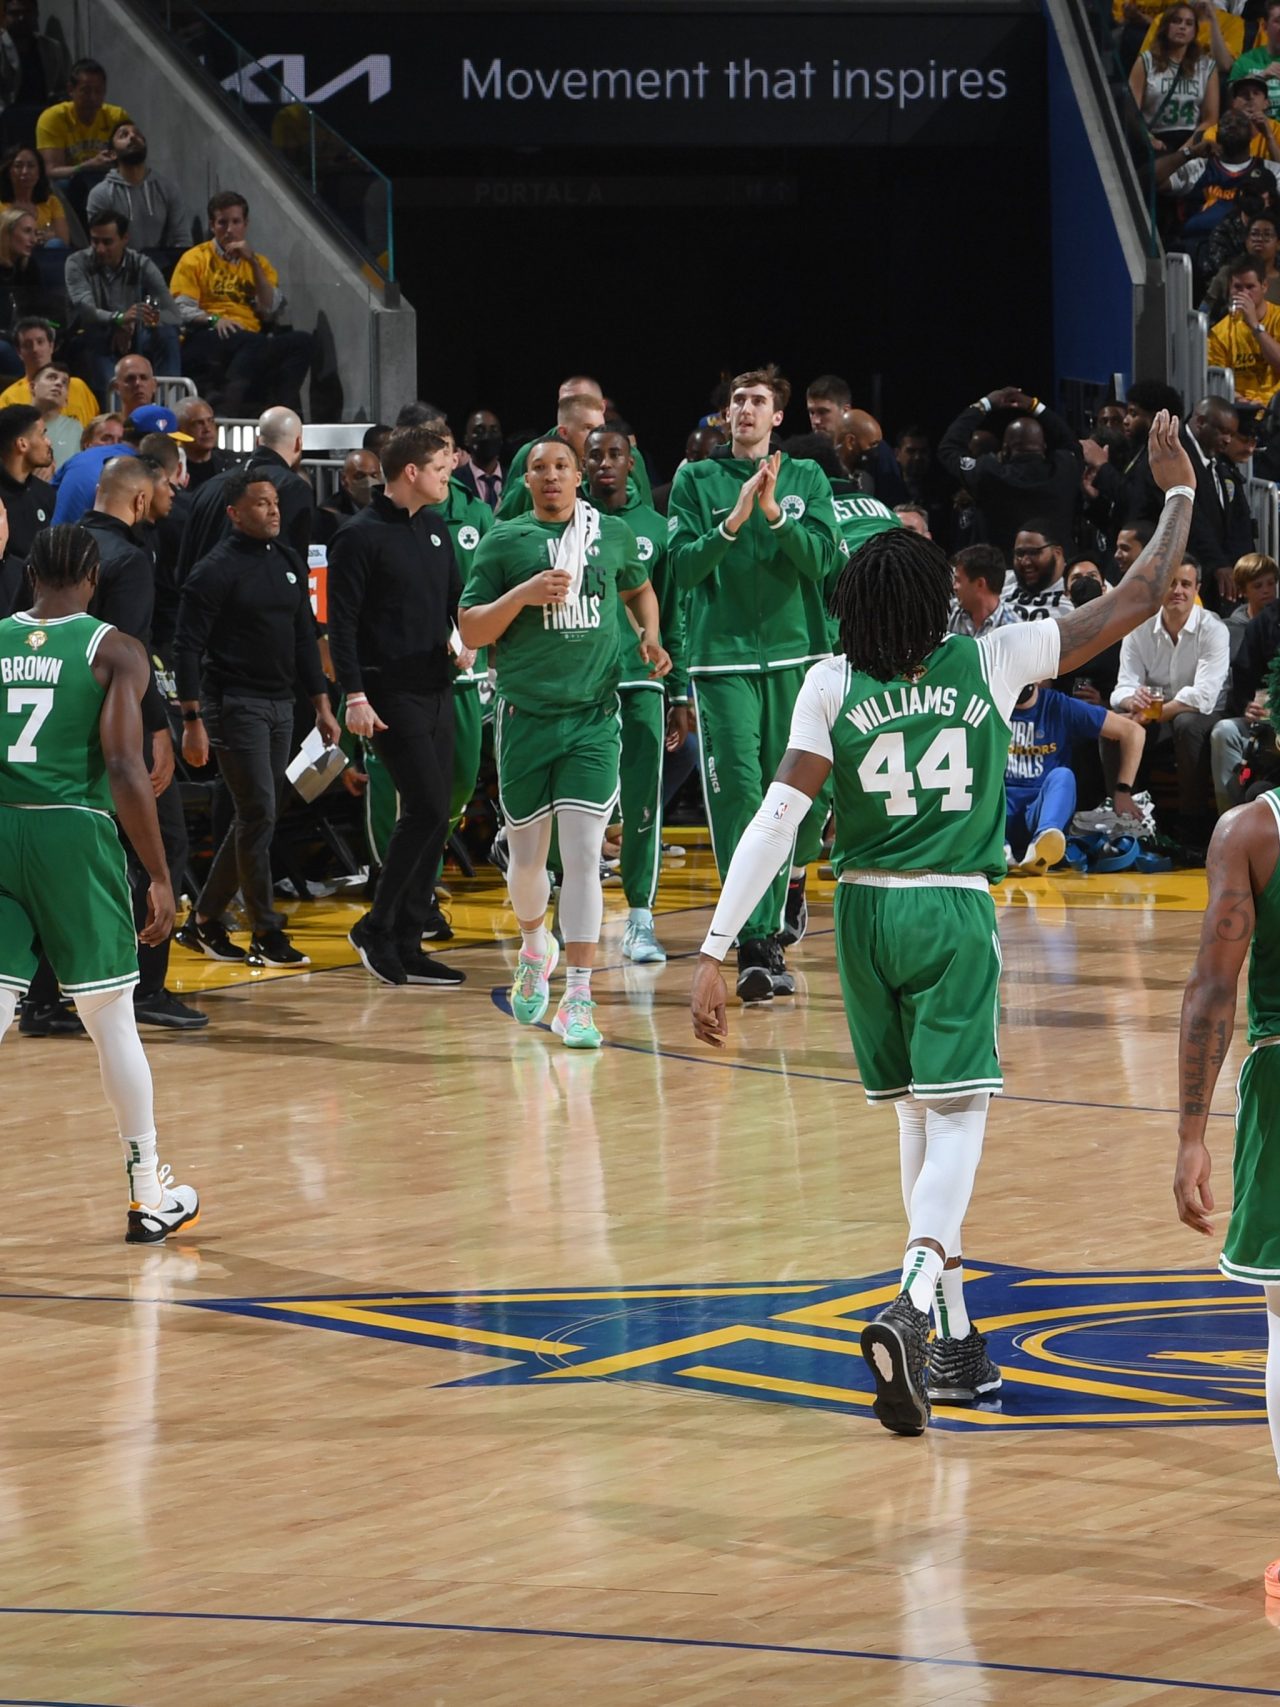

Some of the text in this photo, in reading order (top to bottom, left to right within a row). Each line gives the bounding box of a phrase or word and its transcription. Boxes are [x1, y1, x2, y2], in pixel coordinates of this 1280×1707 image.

[461, 57, 1008, 110] Movement that inspires
[1163, 99, 1195, 126] 34
[834, 501, 893, 522] STON
[543, 595, 602, 631] FINALS
[1, 655, 64, 685] BROWN
[7, 688, 55, 764] 7
[844, 686, 957, 735] WILLIAMS
[857, 726, 975, 817] 44
